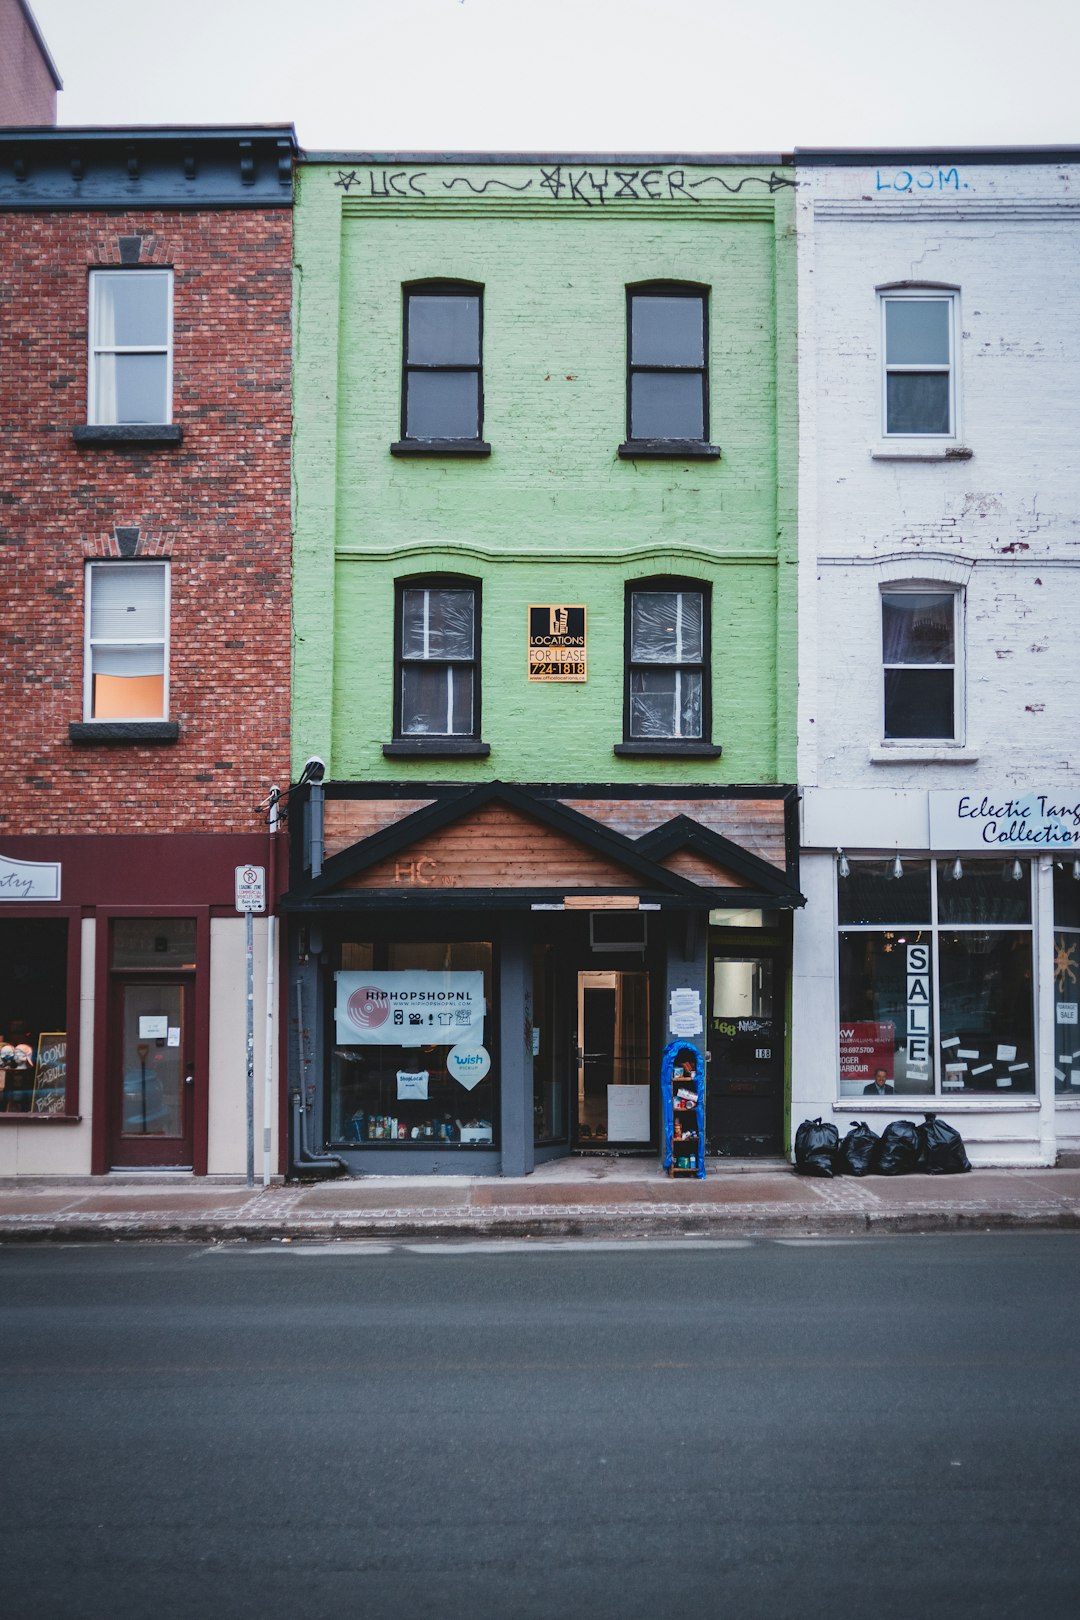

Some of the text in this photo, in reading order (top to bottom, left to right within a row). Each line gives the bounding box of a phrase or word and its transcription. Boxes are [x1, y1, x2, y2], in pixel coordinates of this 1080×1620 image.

[530, 636, 584, 645] LOCATIONS
[529, 650, 585, 661] FOR LEASE
[531, 663, 585, 674] 724-1818
[957, 796, 1032, 818] Eclectic
[366, 991, 473, 1001] HIPHOPSHOPNL
[908, 948, 929, 1062] SALE
[454, 1054, 483, 1065] wish
[840, 1056, 859, 1064] OGER
[840, 1064, 869, 1073] ARBOUR
